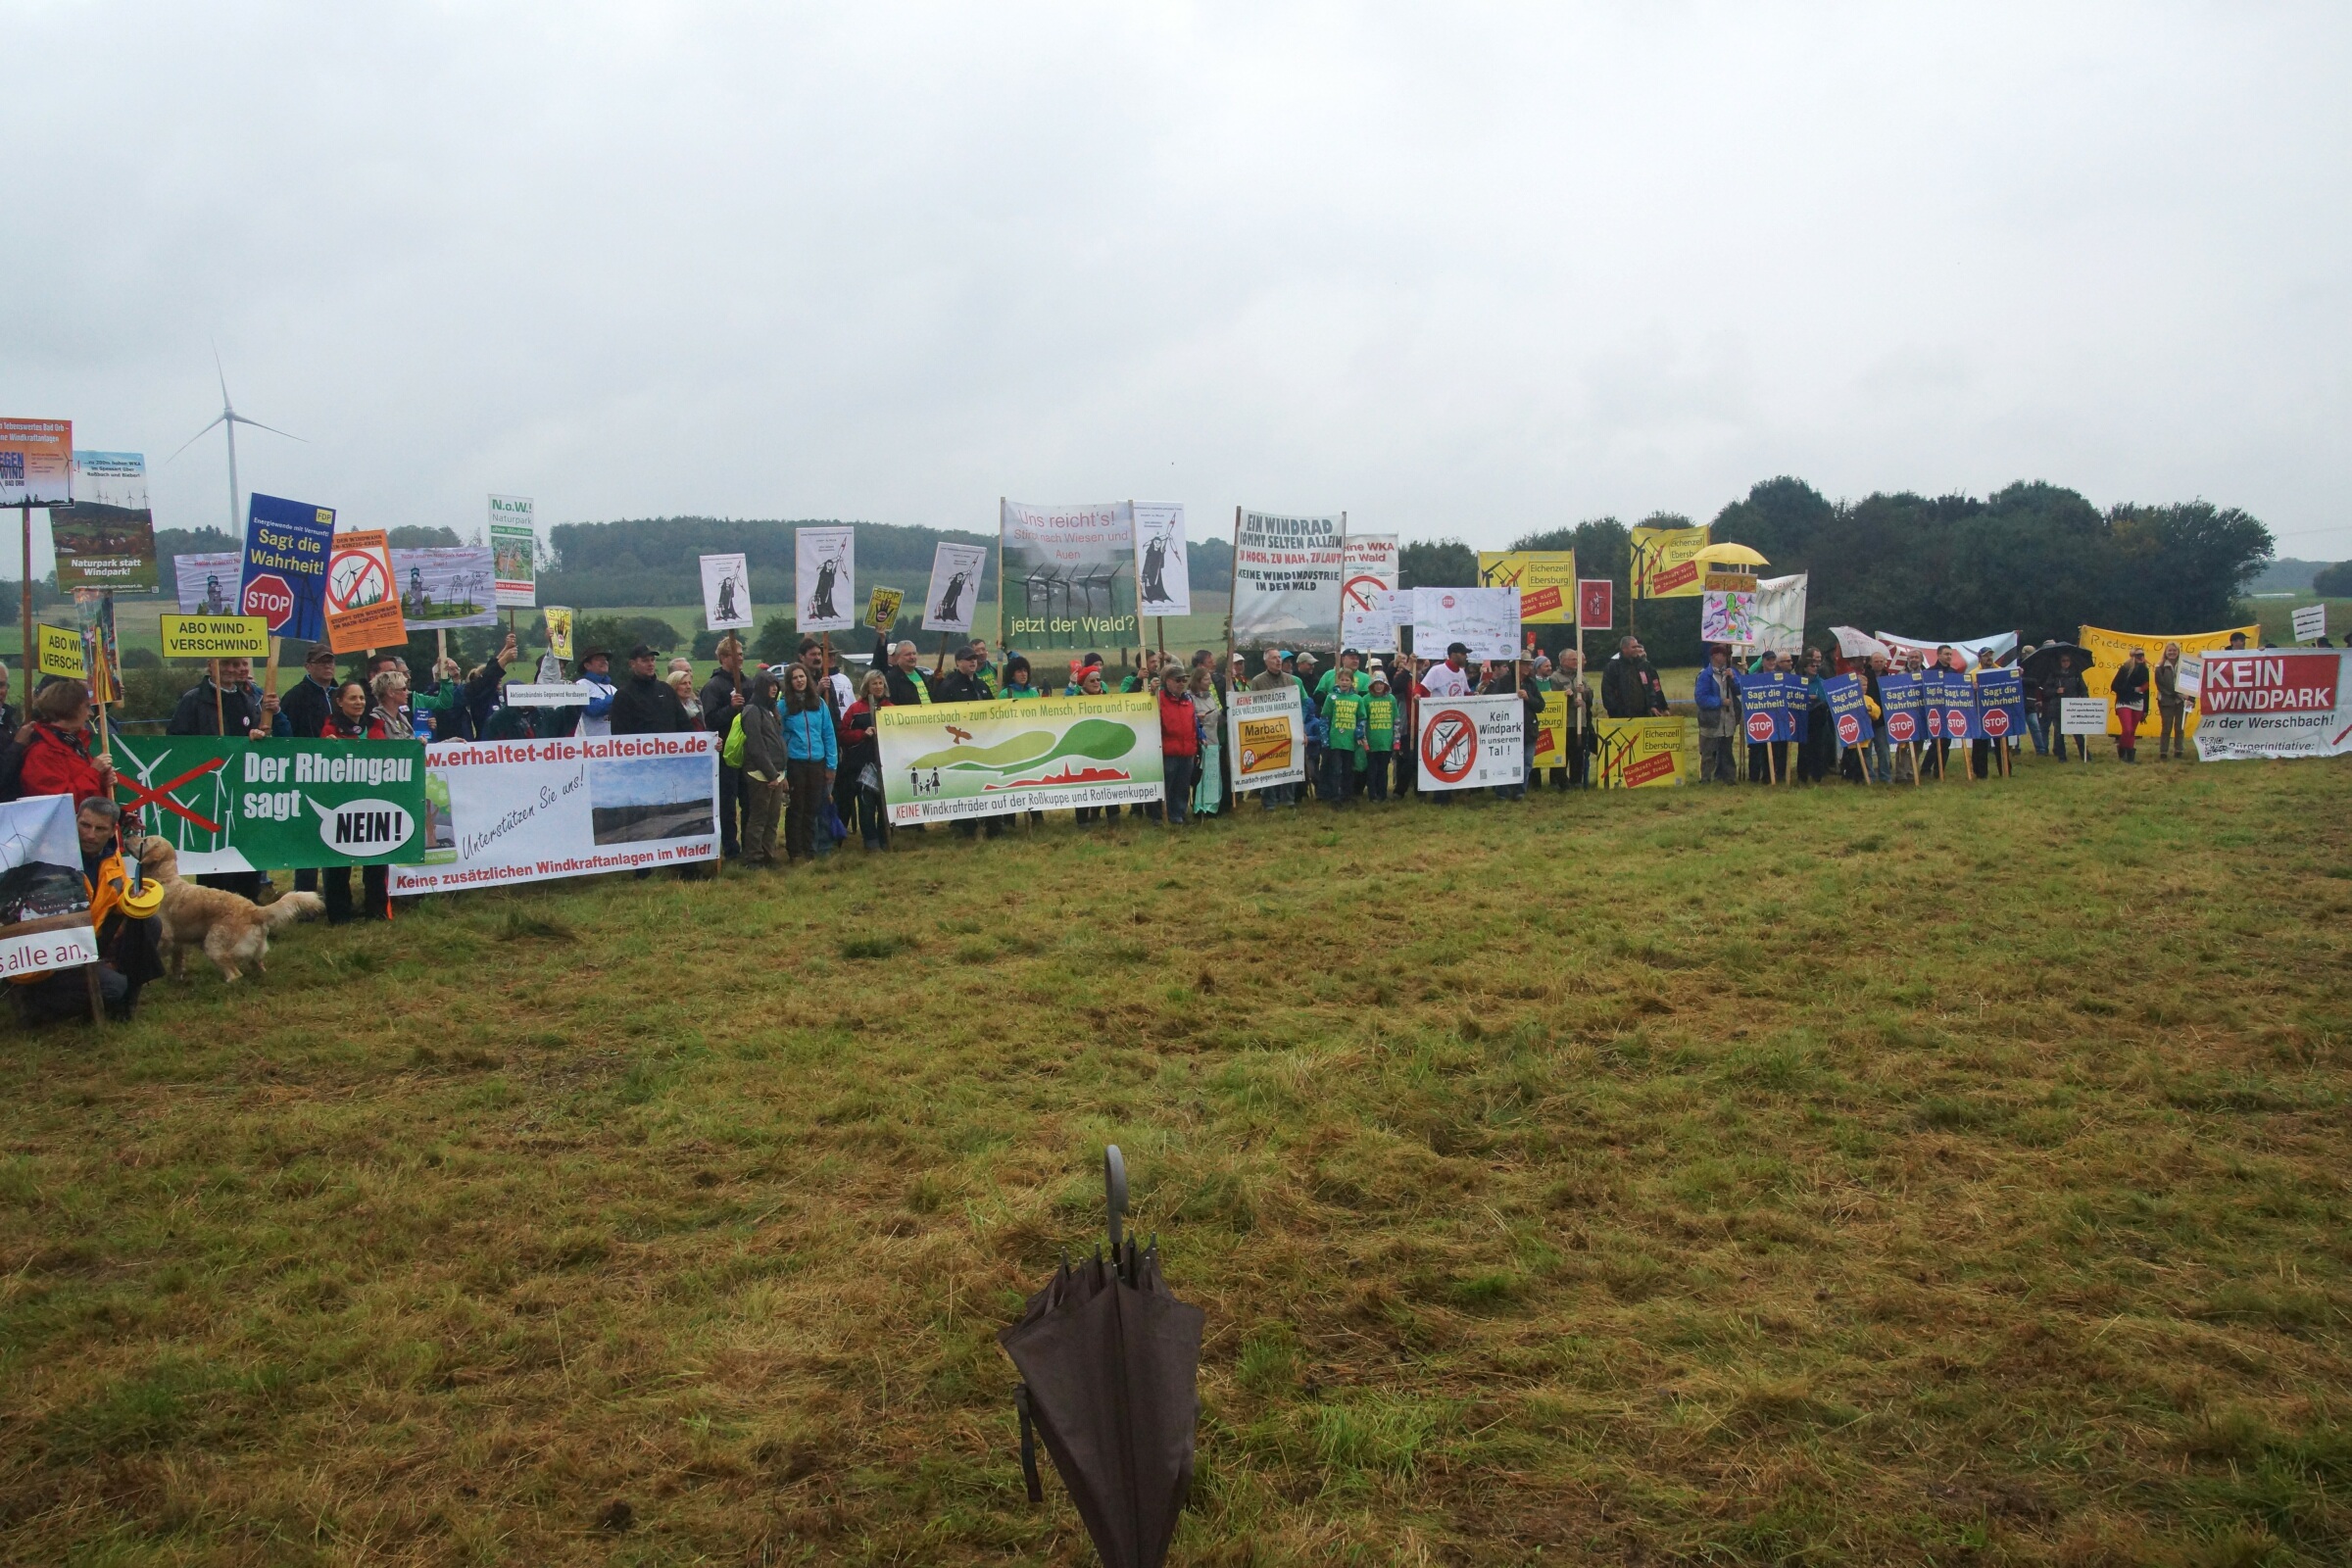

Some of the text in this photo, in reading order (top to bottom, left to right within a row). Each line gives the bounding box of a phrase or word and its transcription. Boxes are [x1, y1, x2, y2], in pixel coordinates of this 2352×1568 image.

[43, 422, 54, 431] Bad
[55, 423, 65, 432] Orb
[9, 433, 60, 443] Windkraftanlagen
[492, 499, 532, 514] N.o.W.!
[318, 512, 332, 521] FDP
[492, 514, 532, 525] Naturpark
[1018, 510, 1045, 528] Uns
[253, 517, 293, 530] Energiewende
[1247, 514, 1333, 536] EIN WINDRAD
[259, 529, 321, 553] Sagt die
[1041, 531, 1128, 543] nach Wiesen und
[1268, 536, 1304, 549] SELTEN
[1307, 536, 1342, 549] ALLEIN
[1367, 542, 1395, 551] WKA
[1055, 549, 1081, 560] Auen
[1246, 551, 1342, 564] HOCH, ZU NAH, ZU LAUT
[1359, 553, 1386, 562] Wald
[72, 559, 118, 568] Naturpark
[251, 549, 324, 575] Wahrheit!
[1530, 564, 1568, 572] Eichenzell
[84, 568, 131, 577] Windpark!
[1238, 569, 1340, 581] KEINE WINDINDUSTRIE
[1256, 582, 1317, 591] IN DEN WALD
[1530, 576, 1568, 585] Ebersburg
[876, 589, 901, 599] STOP
[1540, 591, 1557, 599] nicht
[247, 591, 290, 612] STOP
[179, 623, 245, 634] ABO WIND
[1010, 614, 1135, 636] jetzt der Wald?
[49, 635, 67, 650] ABO
[170, 639, 263, 651] VERSCHWIND!
[2206, 659, 2284, 689] KEIN
[543, 691, 564, 699] Gegenwind
[1747, 688, 1781, 700] Sagt die
[1832, 689, 1859, 703] Sagt die
[1886, 689, 1920, 700] Sagt die
[1944, 689, 1970, 698] Sagt die
[1983, 686, 2017, 697] Sagt die
[1237, 692, 1286, 706] KEINE WINDRÄDER
[1745, 699, 1785, 710] Wahrheit!
[1885, 699, 1925, 710] Wahrheit!
[1981, 695, 2021, 707] Wahrheit!
[2207, 687, 2331, 711] WINDPARK
[1265, 704, 1274, 712] UM
[1274, 701, 1299, 711] MARBACH!
[1833, 697, 1864, 714] Wahrheit!
[884, 699, 1152, 726] BI Dammersbach zum Schutz von Mensch, Flora und Fauna
[1490, 710, 1510, 722] Kein
[1749, 721, 1772, 732] STOP
[1890, 721, 1912, 732] STOP
[1929, 718, 1940, 727] STOP
[1948, 718, 1965, 728] STOP
[1984, 717, 2007, 728] STOP
[2202, 714, 2335, 729] in der Werschbach!
[1245, 721, 1286, 736] Marbach
[1479, 723, 1521, 736] Windpark
[1645, 729, 1680, 738] Eichenzell
[1839, 722, 1857, 735] STOP
[425, 735, 708, 769] w.erhaltet-die-kalteiche.de
[1488, 746, 1504, 757] Tal
[1645, 742, 1680, 751] Ebersburg
[2229, 742, 2315, 752] Bürgerinitiative:
[244, 752, 413, 787] Der Rheingau
[243, 789, 302, 822] sagt
[896, 784, 1158, 819] KEINE Windkrafträder auf der Roßkuppe und Rotlöwenkuppe!
[462, 764, 584, 860] Unterstützen Sie uns!
[396, 843, 711, 889] Keine zusätzlichen Windkraftanlagen im Wald!
[8, 944, 88, 971] alle an,
